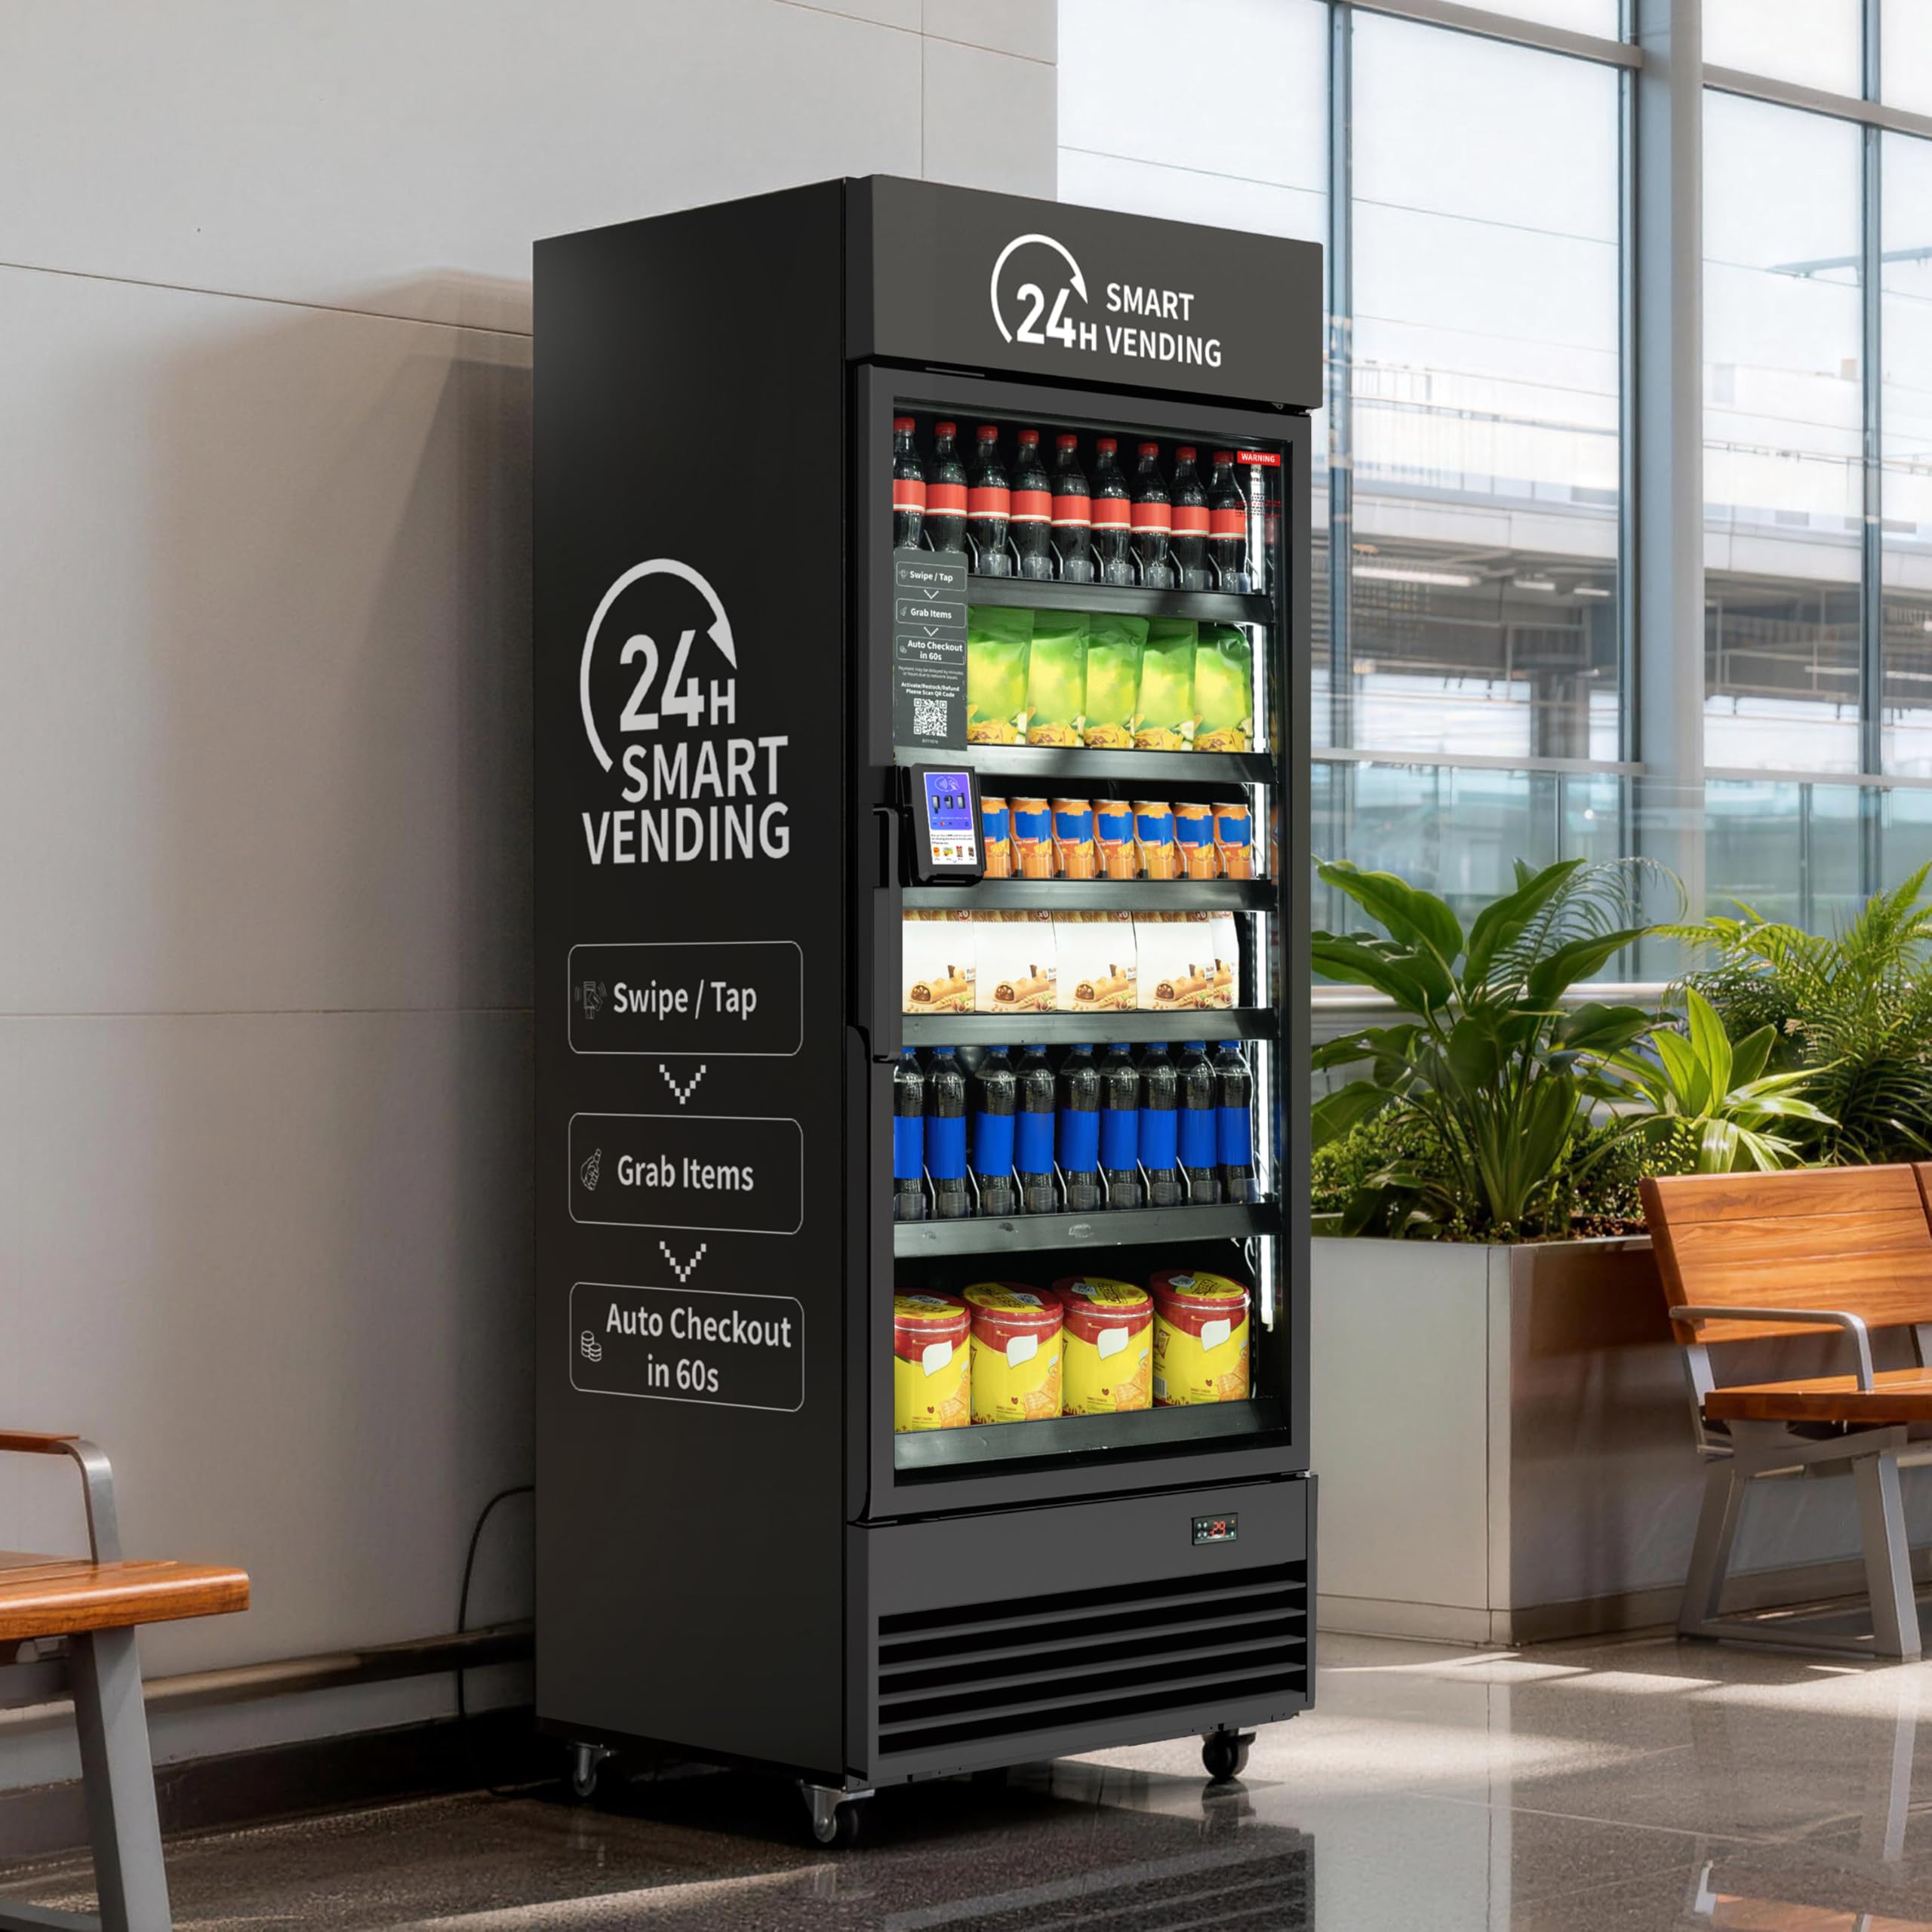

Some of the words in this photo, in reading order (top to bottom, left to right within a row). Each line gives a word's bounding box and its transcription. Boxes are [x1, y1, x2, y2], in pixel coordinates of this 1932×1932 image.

[1017, 282, 1097, 352] 24H
[1106, 282, 1195, 321] SMART
[1105, 325, 1222, 368] VENDING
[1241, 453, 1275, 463] WARNING
[909, 570, 934, 582] Swipe
[934, 571, 938, 581] /
[939, 573, 953, 583] Tap
[910, 608, 929, 617] Grab
[930, 609, 952, 619] Items
[907, 640, 926, 649] Auto
[927, 641, 963, 652] Checkout
[920, 651, 928, 660] in
[928, 651, 943, 661] 60s
[619, 629, 736, 732] 24H
[901, 681, 960, 691] Activate/Restock/Refund
[621, 735, 789, 803] SMART
[582, 801, 790, 865] VENDING
[613, 980, 689, 1020] Swipe
[694, 979, 704, 1020] /
[710, 981, 757, 1020] Tap
[617, 1155, 675, 1189] Grab
[682, 1157, 754, 1192] Items
[606, 1303, 663, 1337] Auto
[670, 1306, 792, 1349] Checkout
[647, 1354, 669, 1388] in
[676, 1357, 719, 1393] 60s
